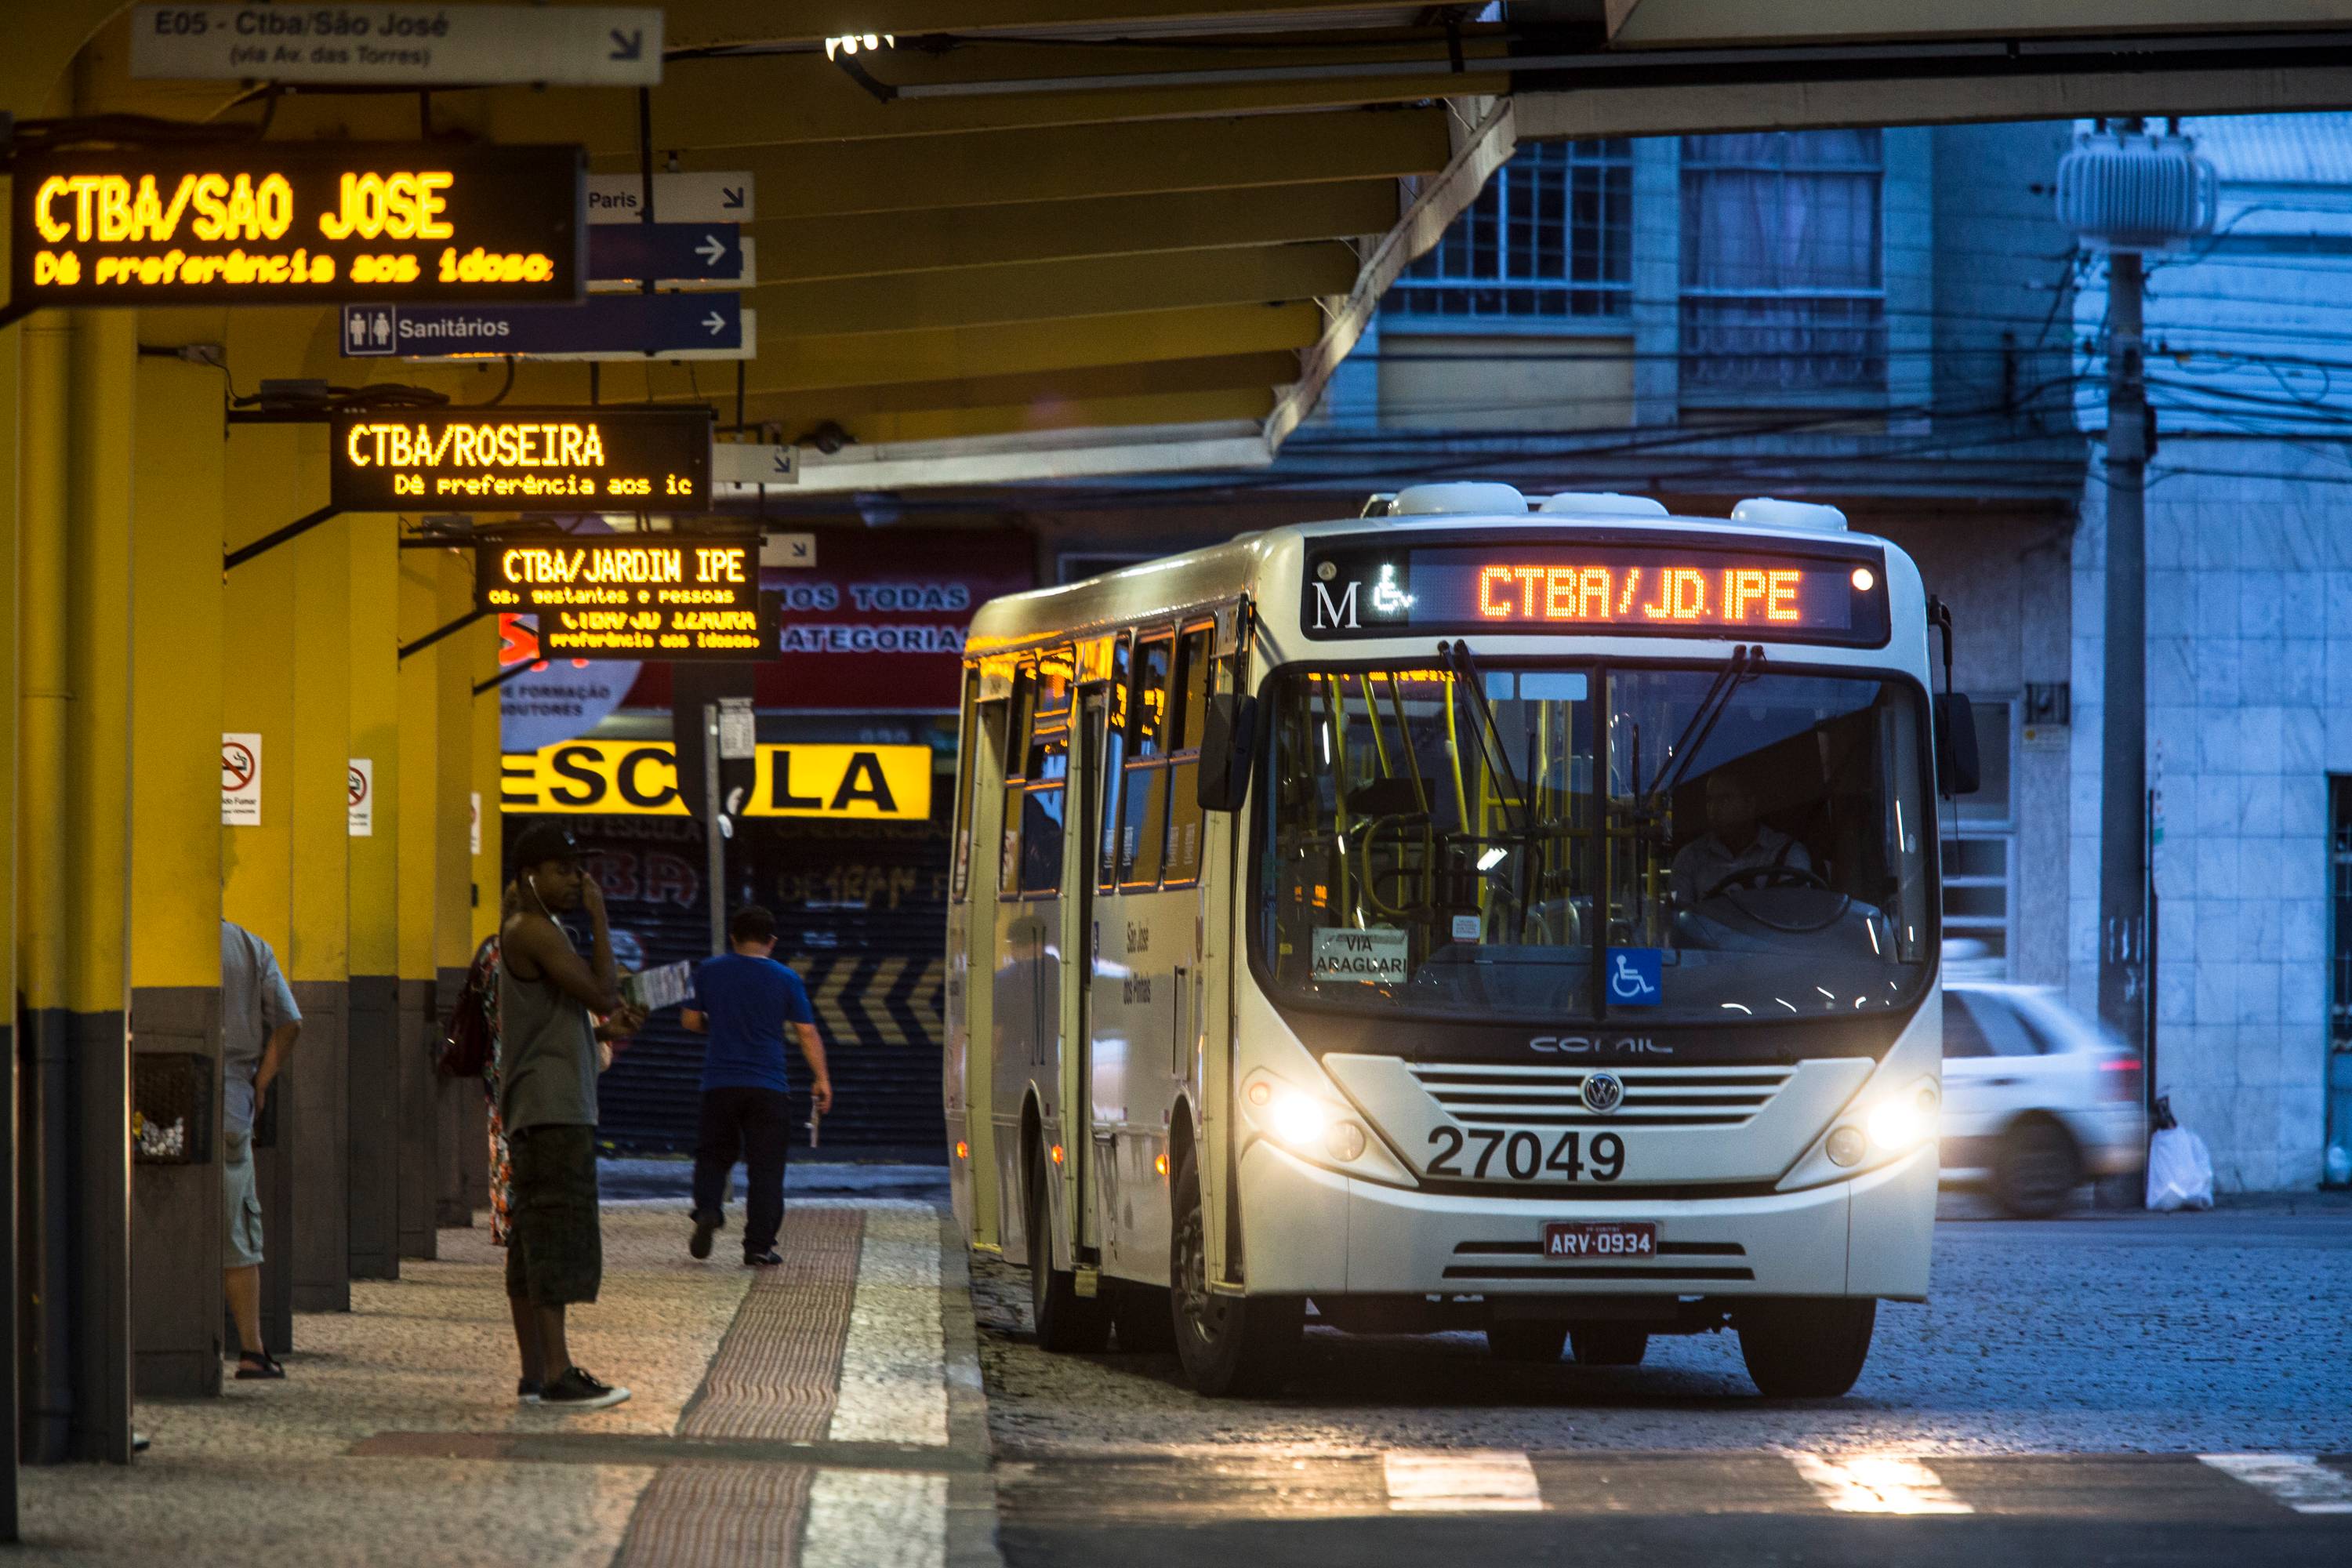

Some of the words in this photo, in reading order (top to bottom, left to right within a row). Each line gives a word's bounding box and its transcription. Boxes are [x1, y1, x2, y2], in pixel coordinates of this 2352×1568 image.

[156, 11, 208, 34] E05
[236, 11, 369, 36] Ctba/São
[379, 12, 448, 36] José
[230, 45, 265, 67] (via
[310, 45, 347, 64] das
[358, 45, 431, 67] Torres)
[35, 174, 292, 242] CTBA/SAO
[318, 172, 454, 239] JOSE
[589, 193, 637, 209] Paris
[350, 253, 421, 283] aos
[398, 317, 510, 338] Sanitários
[348, 423, 604, 467] CTBA/ROSEIRA
[394, 474, 425, 495] Dê
[437, 473, 596, 496] preferência
[607, 477, 652, 495] aos
[695, 548, 746, 582] IPE
[638, 590, 650, 604] e
[658, 590, 735, 604] pessoas
[783, 586, 837, 612] OS
[851, 586, 970, 612] TODAS
[1312, 581, 1362, 628] M
[782, 625, 970, 652] ATEGORIA
[501, 746, 898, 814] ESCLA
[1347, 935, 1373, 953] VIA
[1316, 957, 1407, 973] ARAGUARI
[1426, 1125, 1625, 1182] 27049
